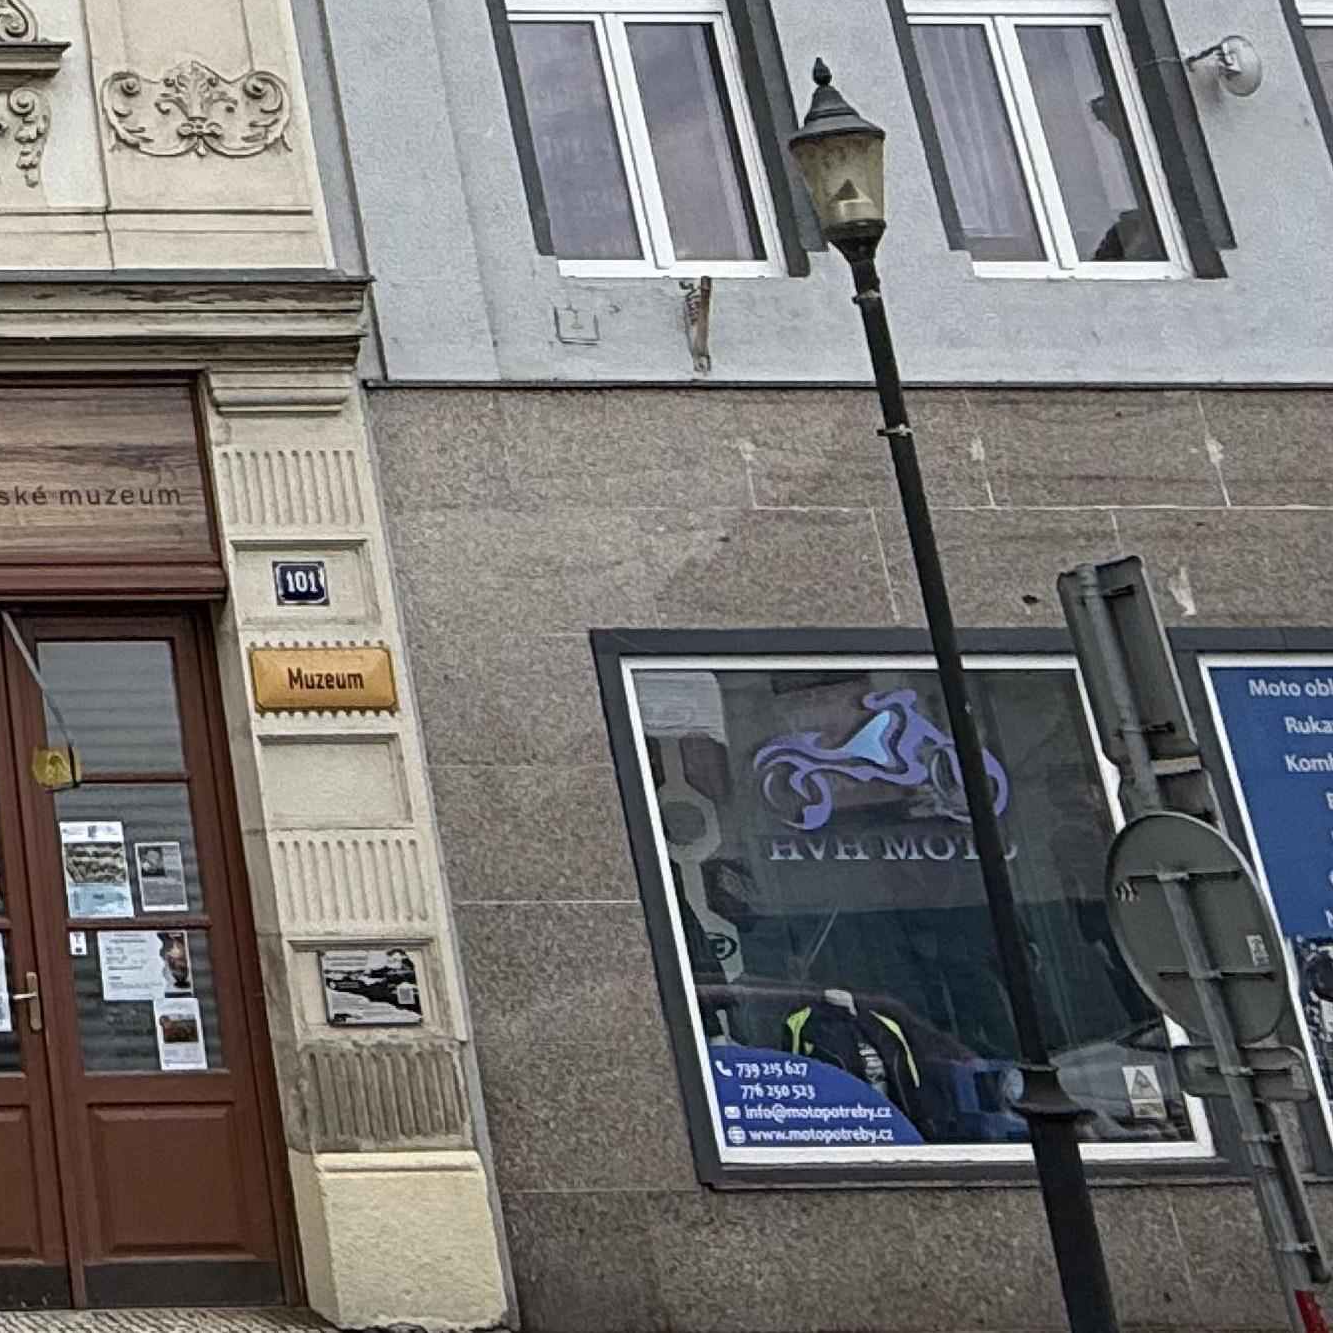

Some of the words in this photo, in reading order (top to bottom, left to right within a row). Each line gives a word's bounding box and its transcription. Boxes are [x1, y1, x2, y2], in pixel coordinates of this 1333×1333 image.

[59, 486, 182, 506] muzeum
[286, 570, 319, 593] 101
[287, 667, 365, 690] Muzeum
[1248, 678, 1301, 697] Moto
[769, 832, 870, 860] HVH
[883, 832, 1019, 861] MOT
[744, 1102, 893, 1123] info@motopotreby.cz
[748, 1125, 894, 1143] www.motopotreby.cz
